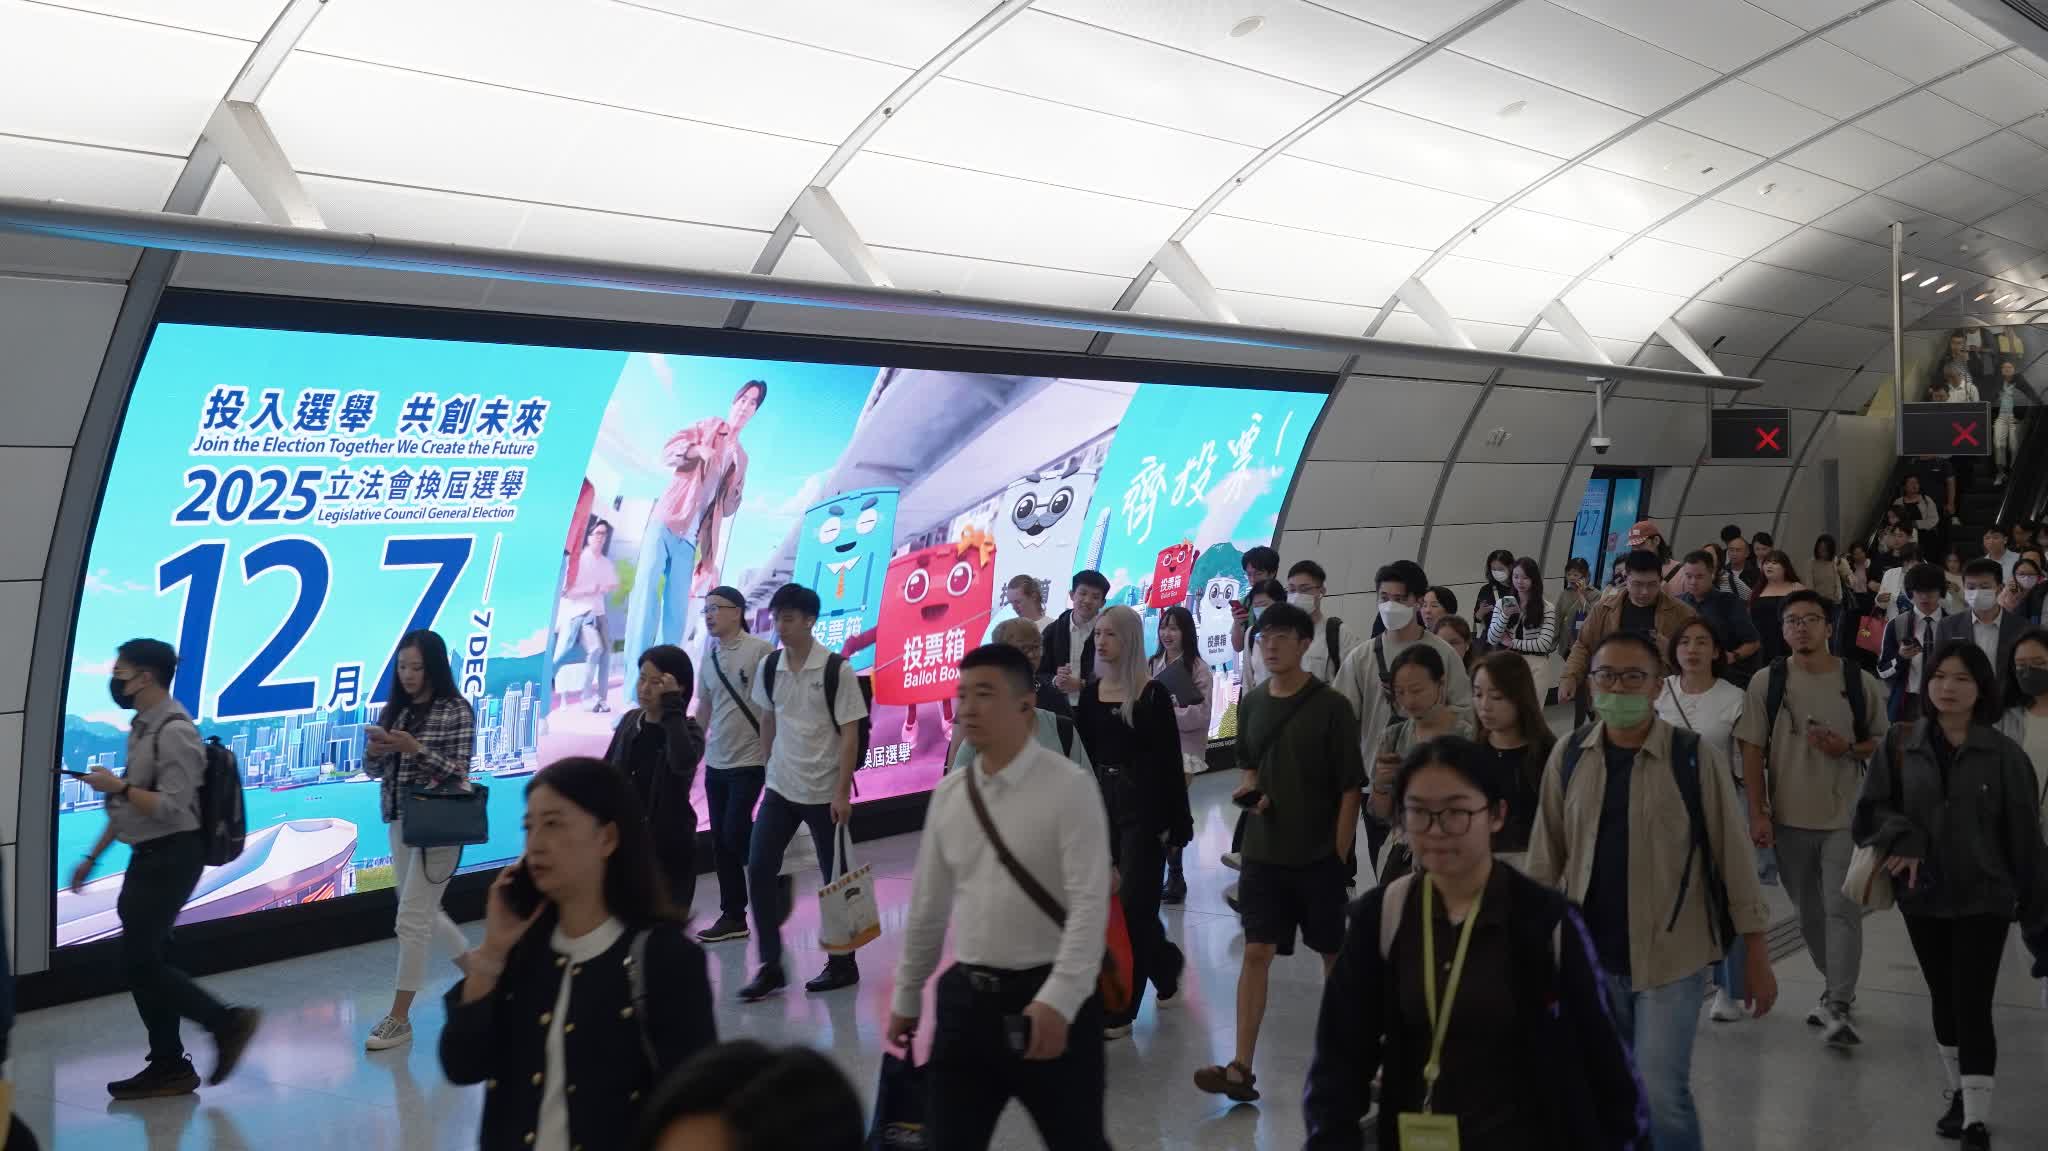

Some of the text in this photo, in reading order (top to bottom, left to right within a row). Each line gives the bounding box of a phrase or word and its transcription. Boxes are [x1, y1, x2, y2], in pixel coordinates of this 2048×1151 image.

[203, 389, 547, 436] 投入選舉 共創未來
[194, 436, 535, 456] Join the Election Together We Create the Future
[176, 469, 525, 521] 2025 立法會換屆選舉
[318, 506, 514, 523] Legislative Council General Election
[159, 537, 474, 721] 12 月 7
[903, 628, 966, 672] 投票箱
[464, 611, 491, 693] 7 DEC
[903, 666, 961, 689] Ballot Box
